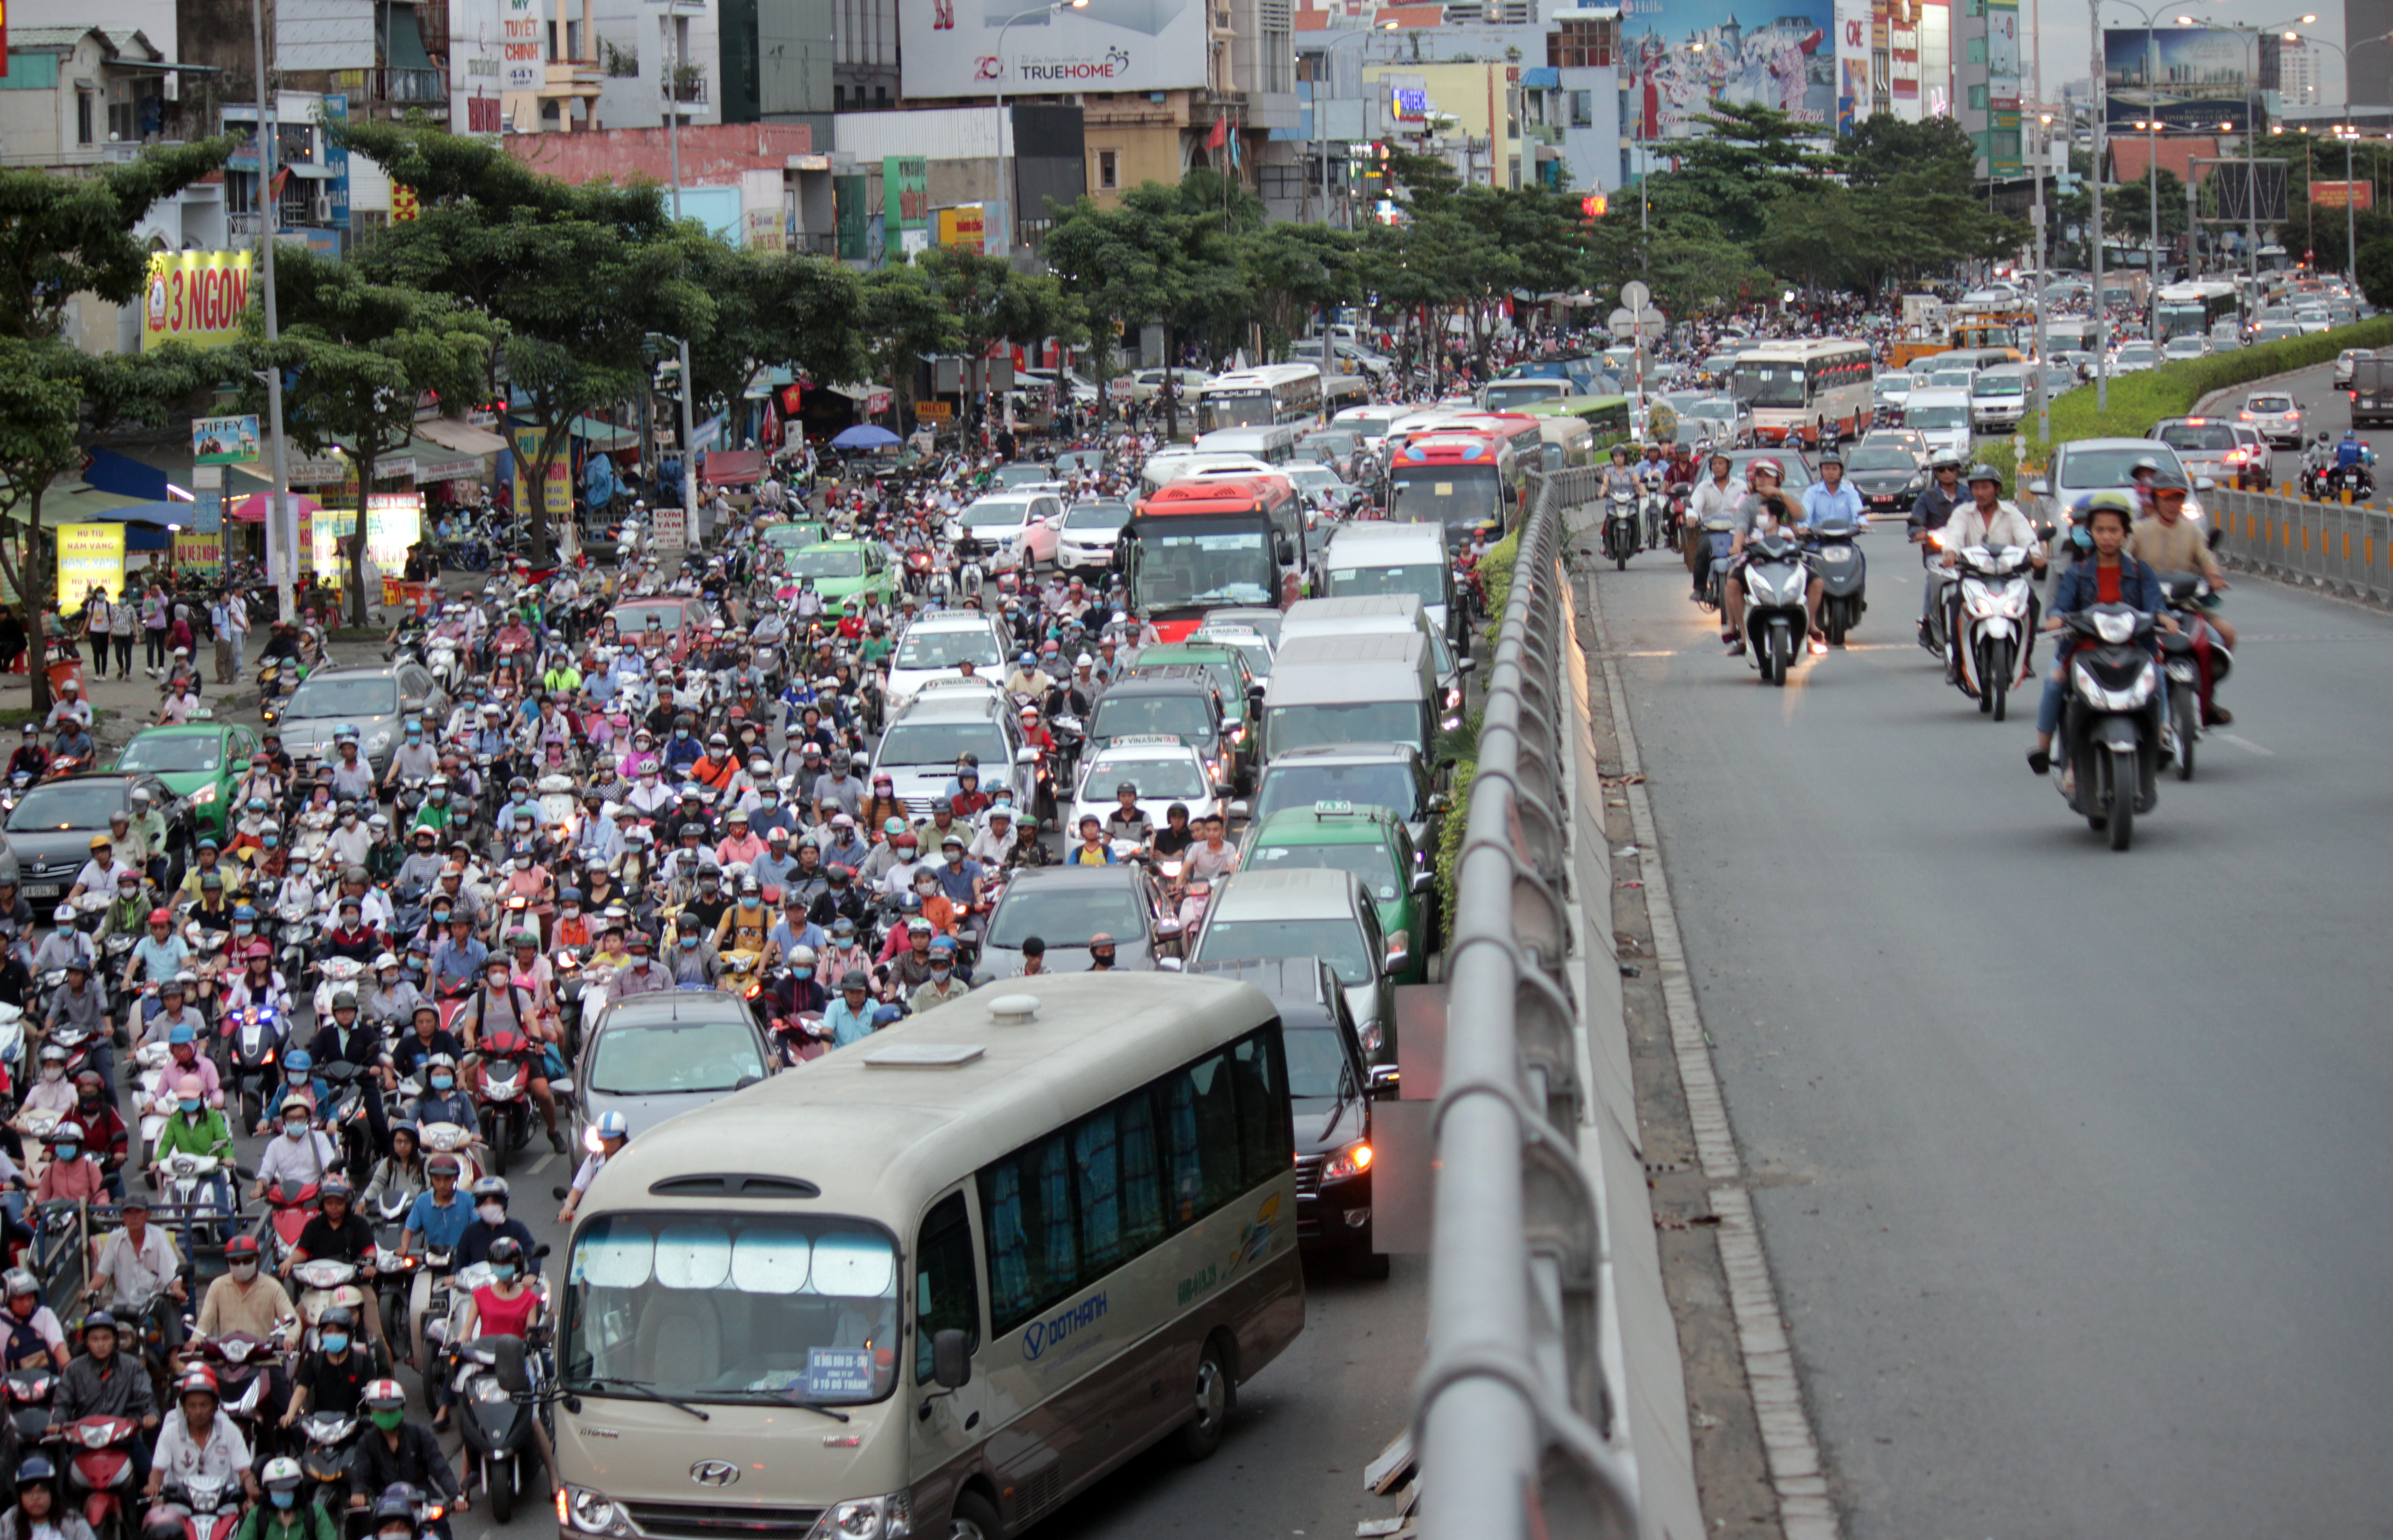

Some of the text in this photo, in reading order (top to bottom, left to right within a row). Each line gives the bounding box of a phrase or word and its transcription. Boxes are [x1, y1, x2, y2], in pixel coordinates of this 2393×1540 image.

[505, 12, 538, 37] TUYẾT
[1846, 19, 1863, 48] CAE
[505, 43, 538, 60] CHINH
[510, 70, 533, 78] 441
[1021, 64, 1114, 79] TRUEHOME
[1400, 90, 1427, 111] HUTECH
[170, 267, 248, 331] 3 NGON
[199, 420, 243, 433] TIFFY
[368, 495, 418, 508] QUÁN 3 NGON
[656, 510, 681, 518] CƠM
[197, 545, 201, 561] 3
[203, 545, 219, 561] NGON
[92, 557, 120, 569] XANH
[1318, 801, 1348, 811] TAXI
[1049, 1290, 1107, 1347] DOTHANH
[820, 1377, 830, 1390] TÔ
[580, 1427, 619, 1438] HYUNDAI
